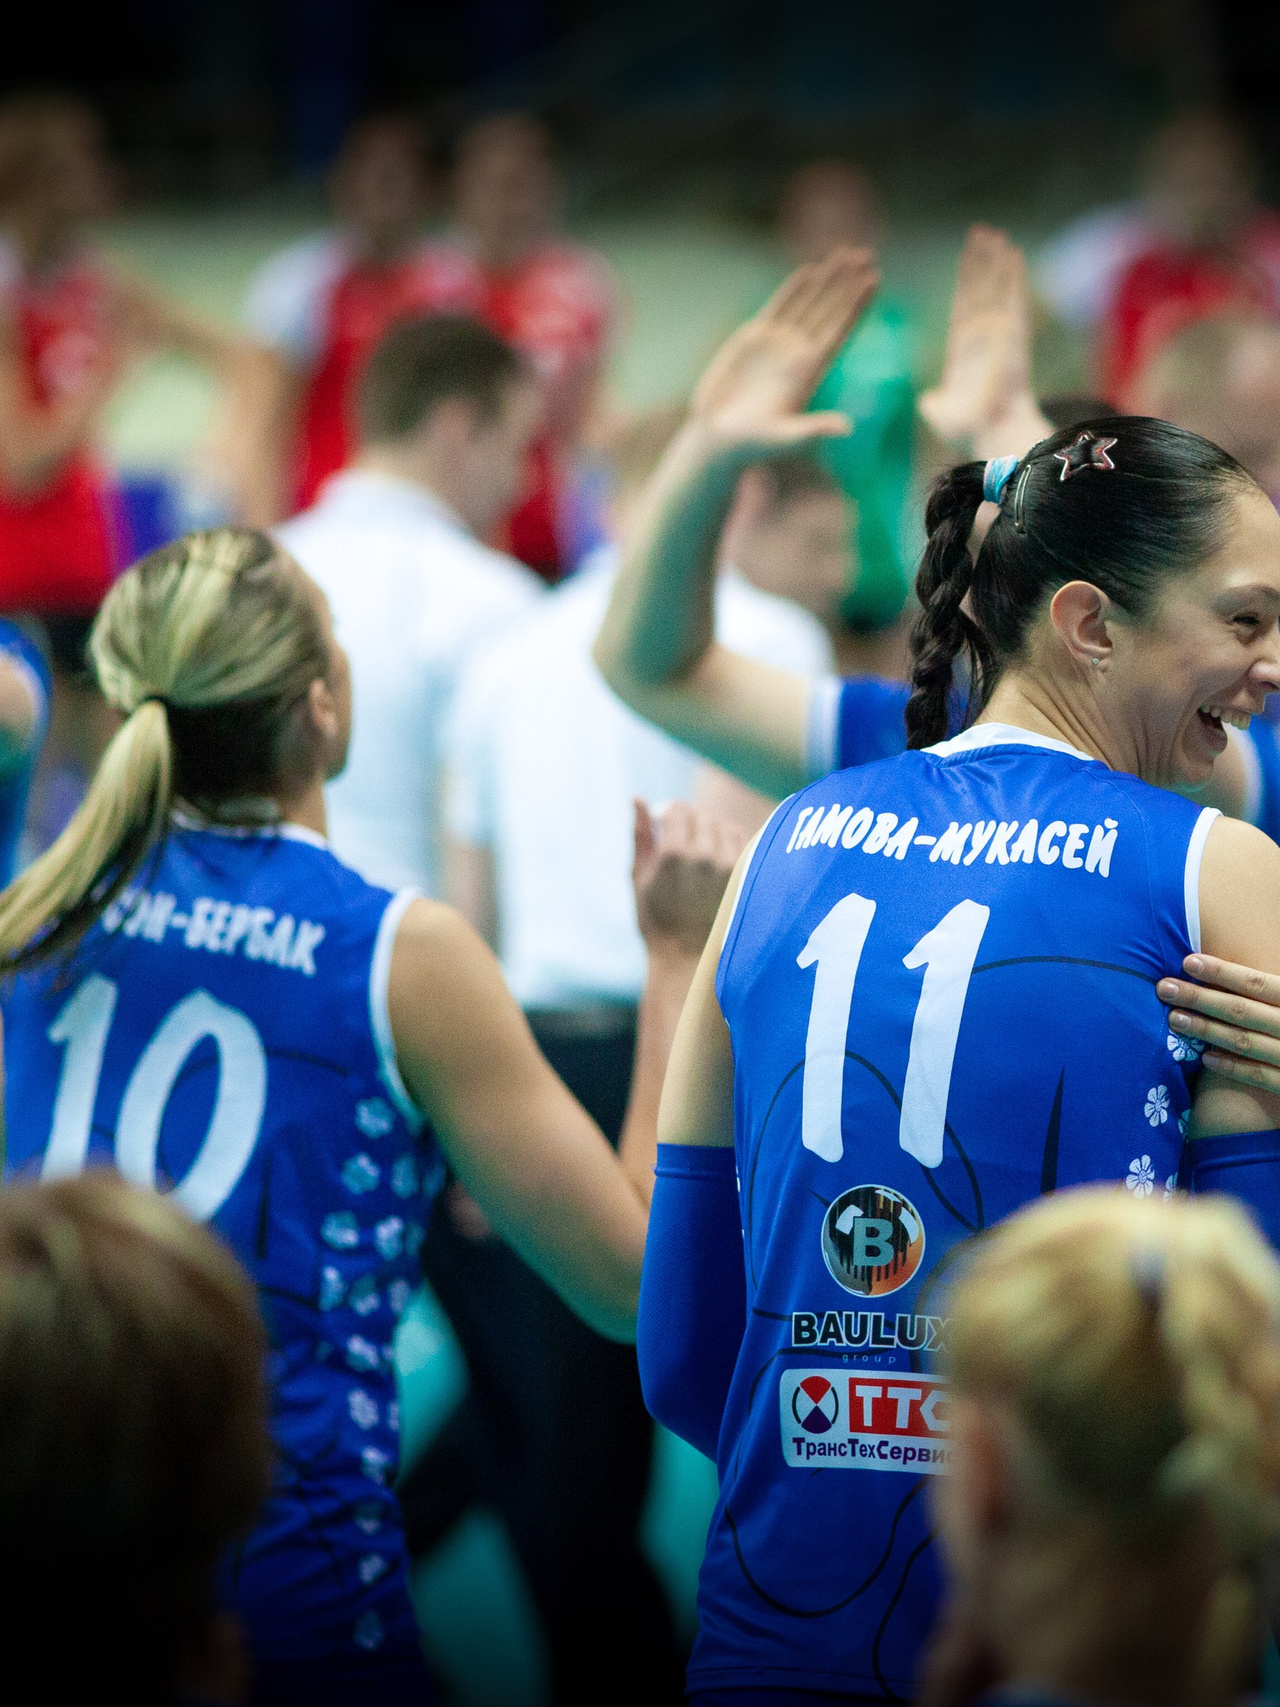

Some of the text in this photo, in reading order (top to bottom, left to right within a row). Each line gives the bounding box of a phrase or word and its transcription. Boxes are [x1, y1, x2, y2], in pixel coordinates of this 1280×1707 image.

[786, 803, 1119, 878] ГАМОВА-МУКАСЕЙ
[796, 892, 991, 1168] 11
[40, 973, 268, 1223] 10
[851, 1216, 896, 1267] B
[791, 1311, 952, 1352] BAULUX
[841, 1353, 897, 1366] group
[791, 1436, 951, 1466] ТрансТехСерви
